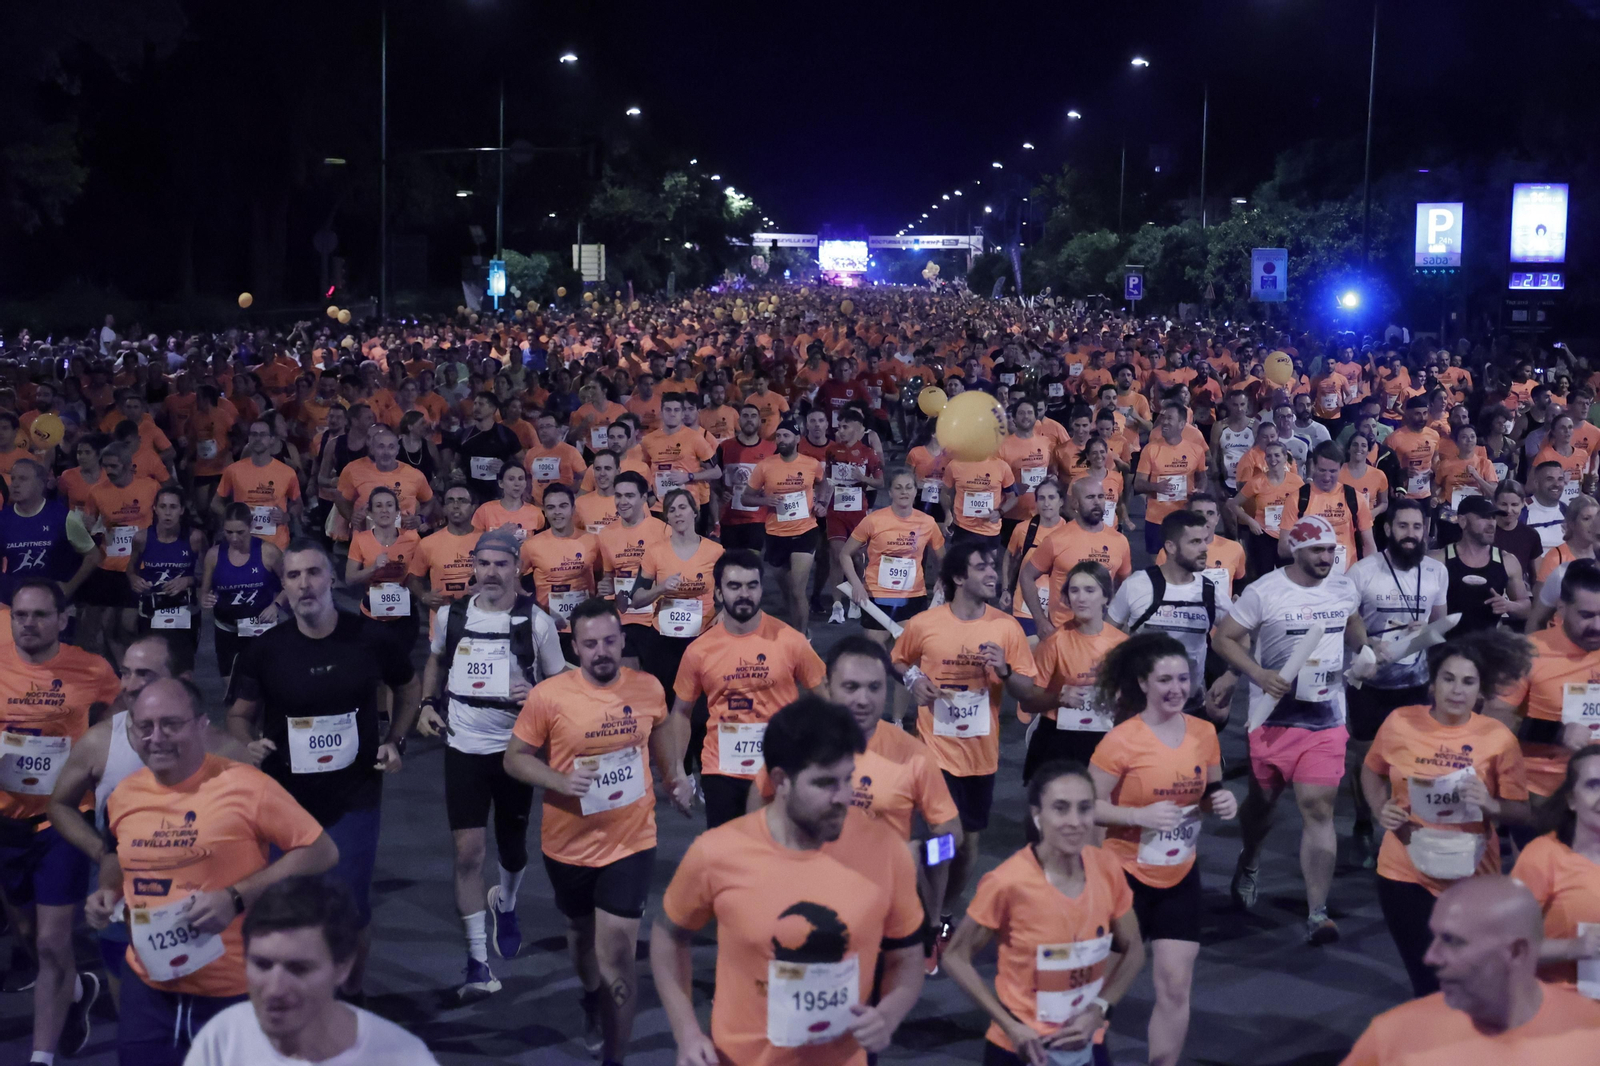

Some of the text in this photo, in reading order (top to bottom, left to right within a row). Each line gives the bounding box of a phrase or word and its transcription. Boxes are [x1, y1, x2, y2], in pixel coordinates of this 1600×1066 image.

[1428, 209, 1454, 244] P
[1129, 277, 1139, 288] P
[889, 567, 908, 578] 5919
[381, 593, 401, 603] 9863
[669, 611, 692, 622] 6282
[1285, 613, 1294, 621] EL
[467, 662, 493, 675] 2831
[723, 673, 751, 682] SEVILLA
[601, 719, 638, 729] NOCTURNA
[585, 728, 619, 739] SEVILLA
[309, 733, 342, 749] 8600
[734, 741, 763, 753] 4779
[16, 756, 51, 771] 4968
[593, 765, 634, 788] 14982
[152, 829, 198, 838] NOCTURNA
[131, 839, 172, 848] SEVILLA
